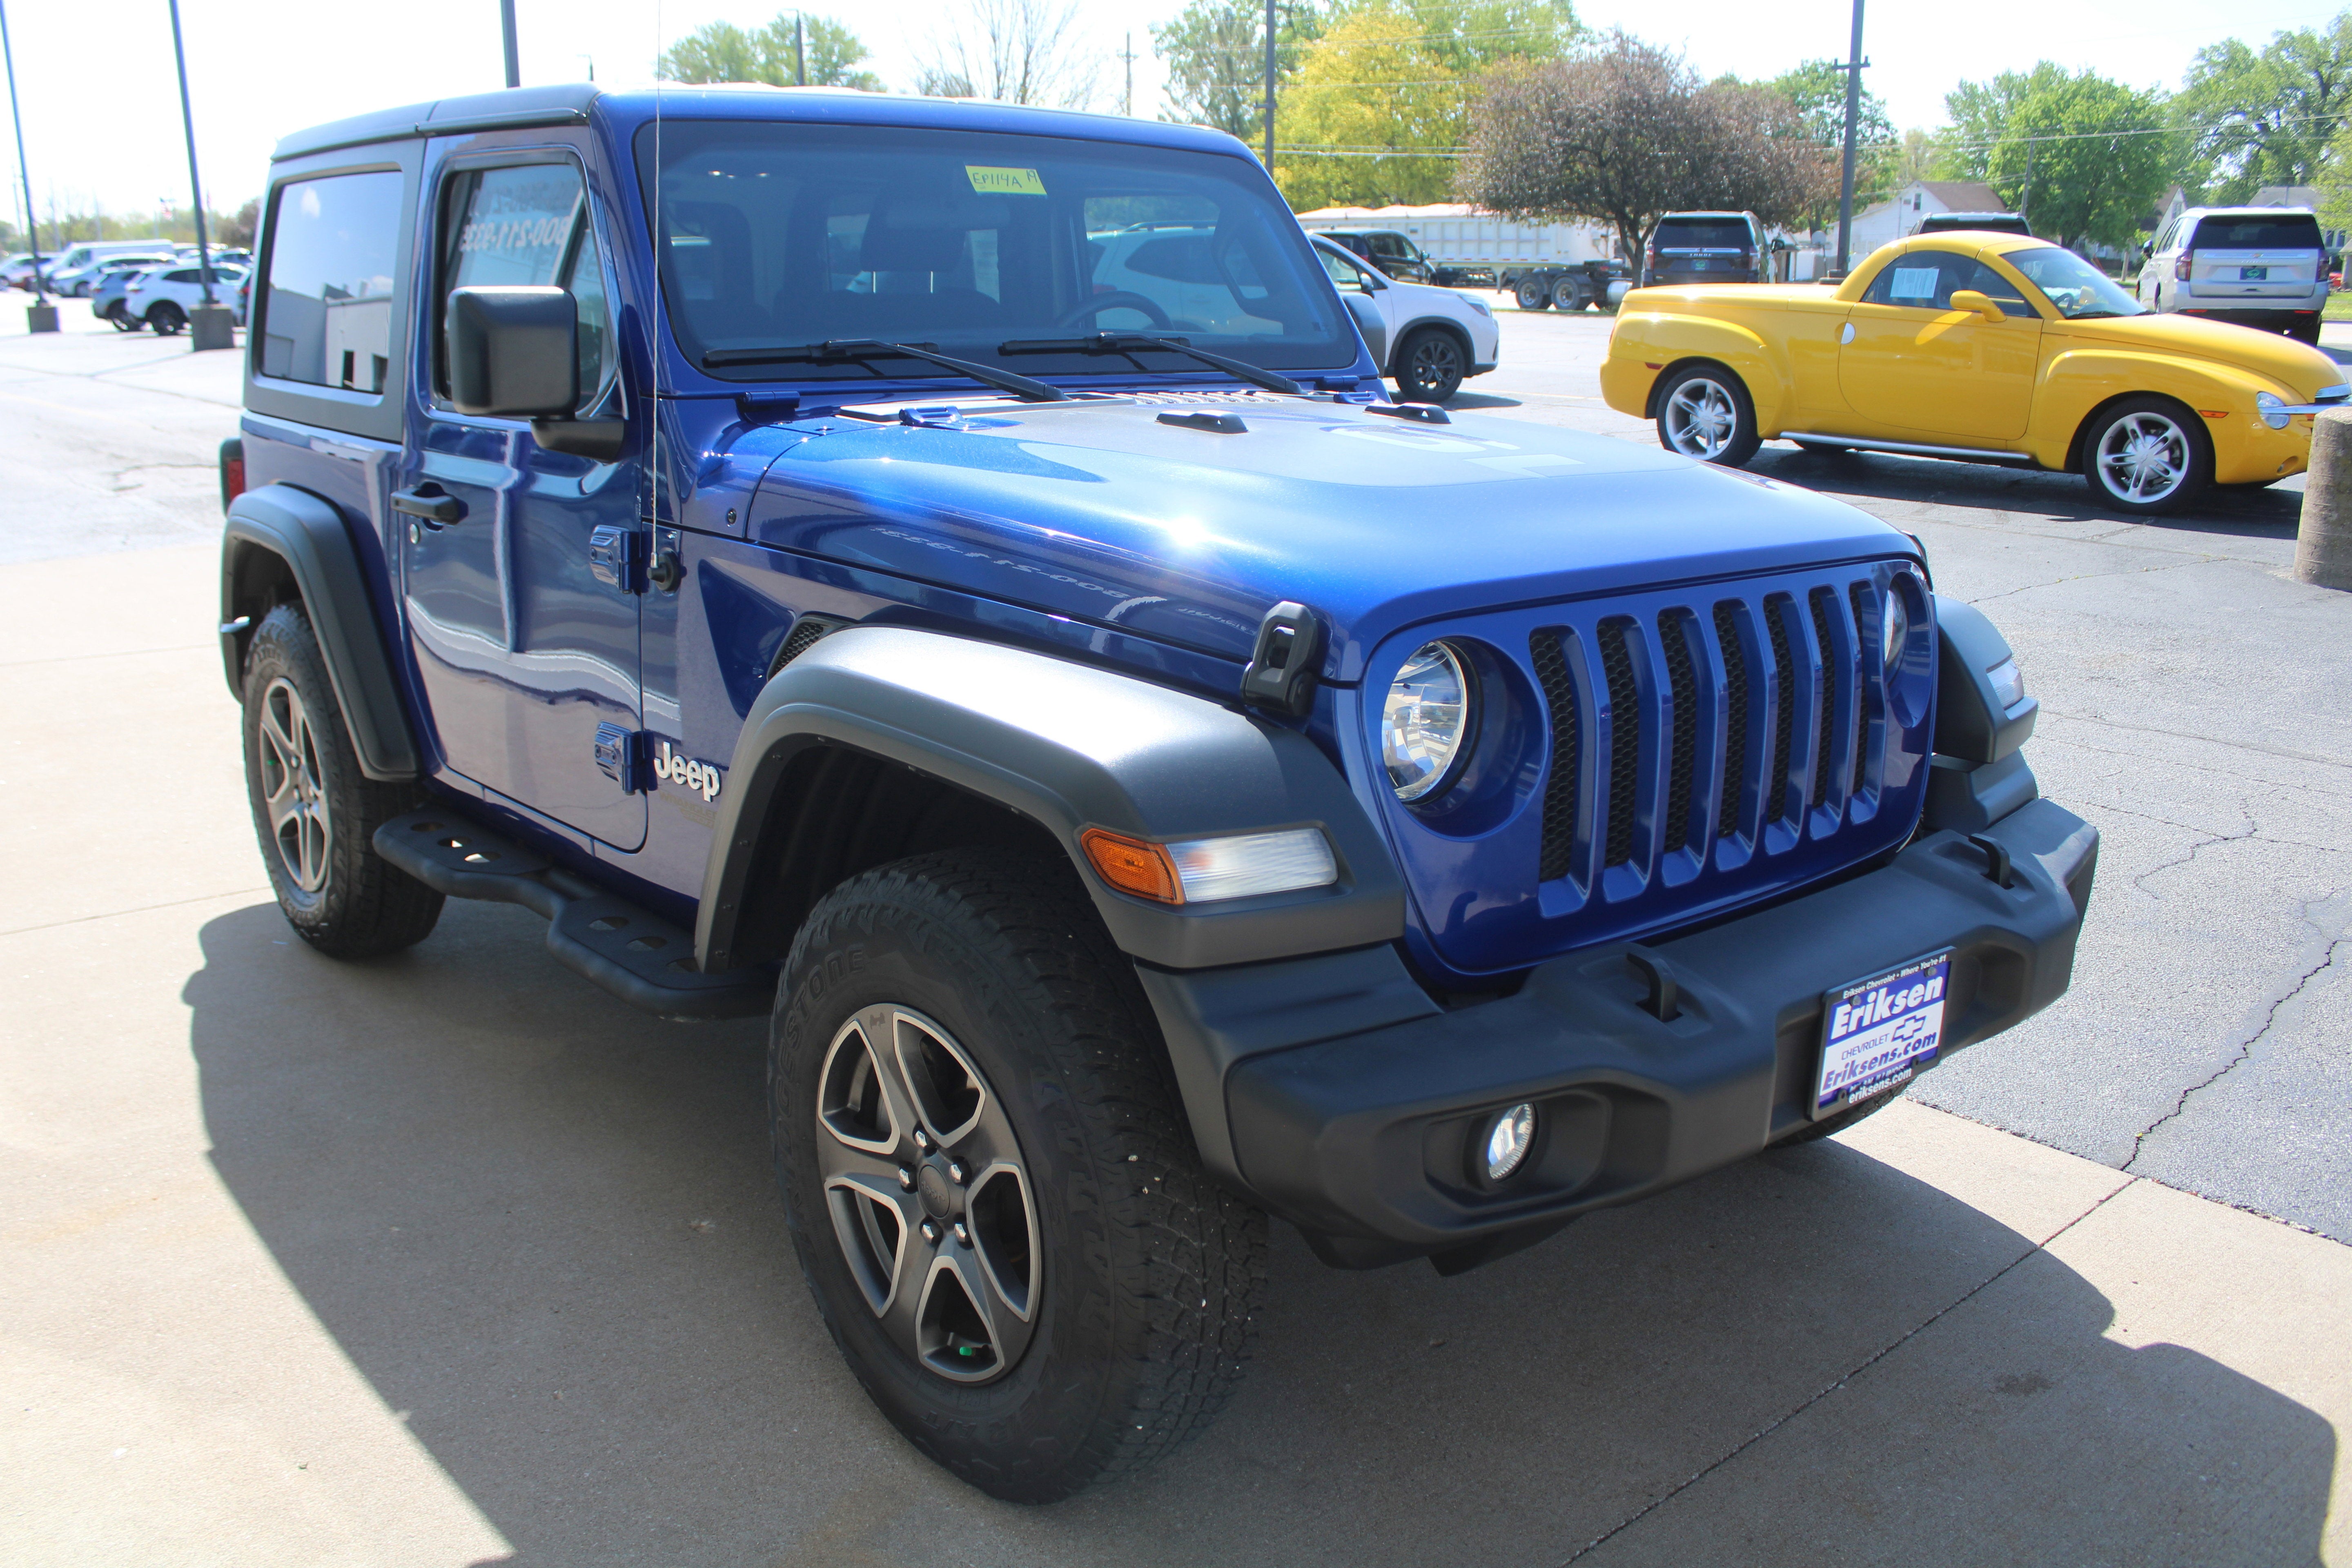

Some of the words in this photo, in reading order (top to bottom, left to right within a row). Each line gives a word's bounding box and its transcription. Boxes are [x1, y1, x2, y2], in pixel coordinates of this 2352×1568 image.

[973, 172, 1022, 188] EP114A
[654, 741, 720, 802] Jeep
[1843, 985, 1865, 999] Eriksen
[1866, 973, 1896, 990] Chevrolet
[1900, 966, 1919, 977] Where
[1920, 958, 1938, 970] You're
[1939, 954, 1947, 963] #1
[1831, 976, 1943, 1040] Eriksen
[1822, 1032, 1937, 1092] Eriksens.com
[1841, 1033, 1890, 1060] CHEVROLET
[1849, 1068, 1912, 1104] eriksens.com
[920, 1410, 977, 1439] A/T
